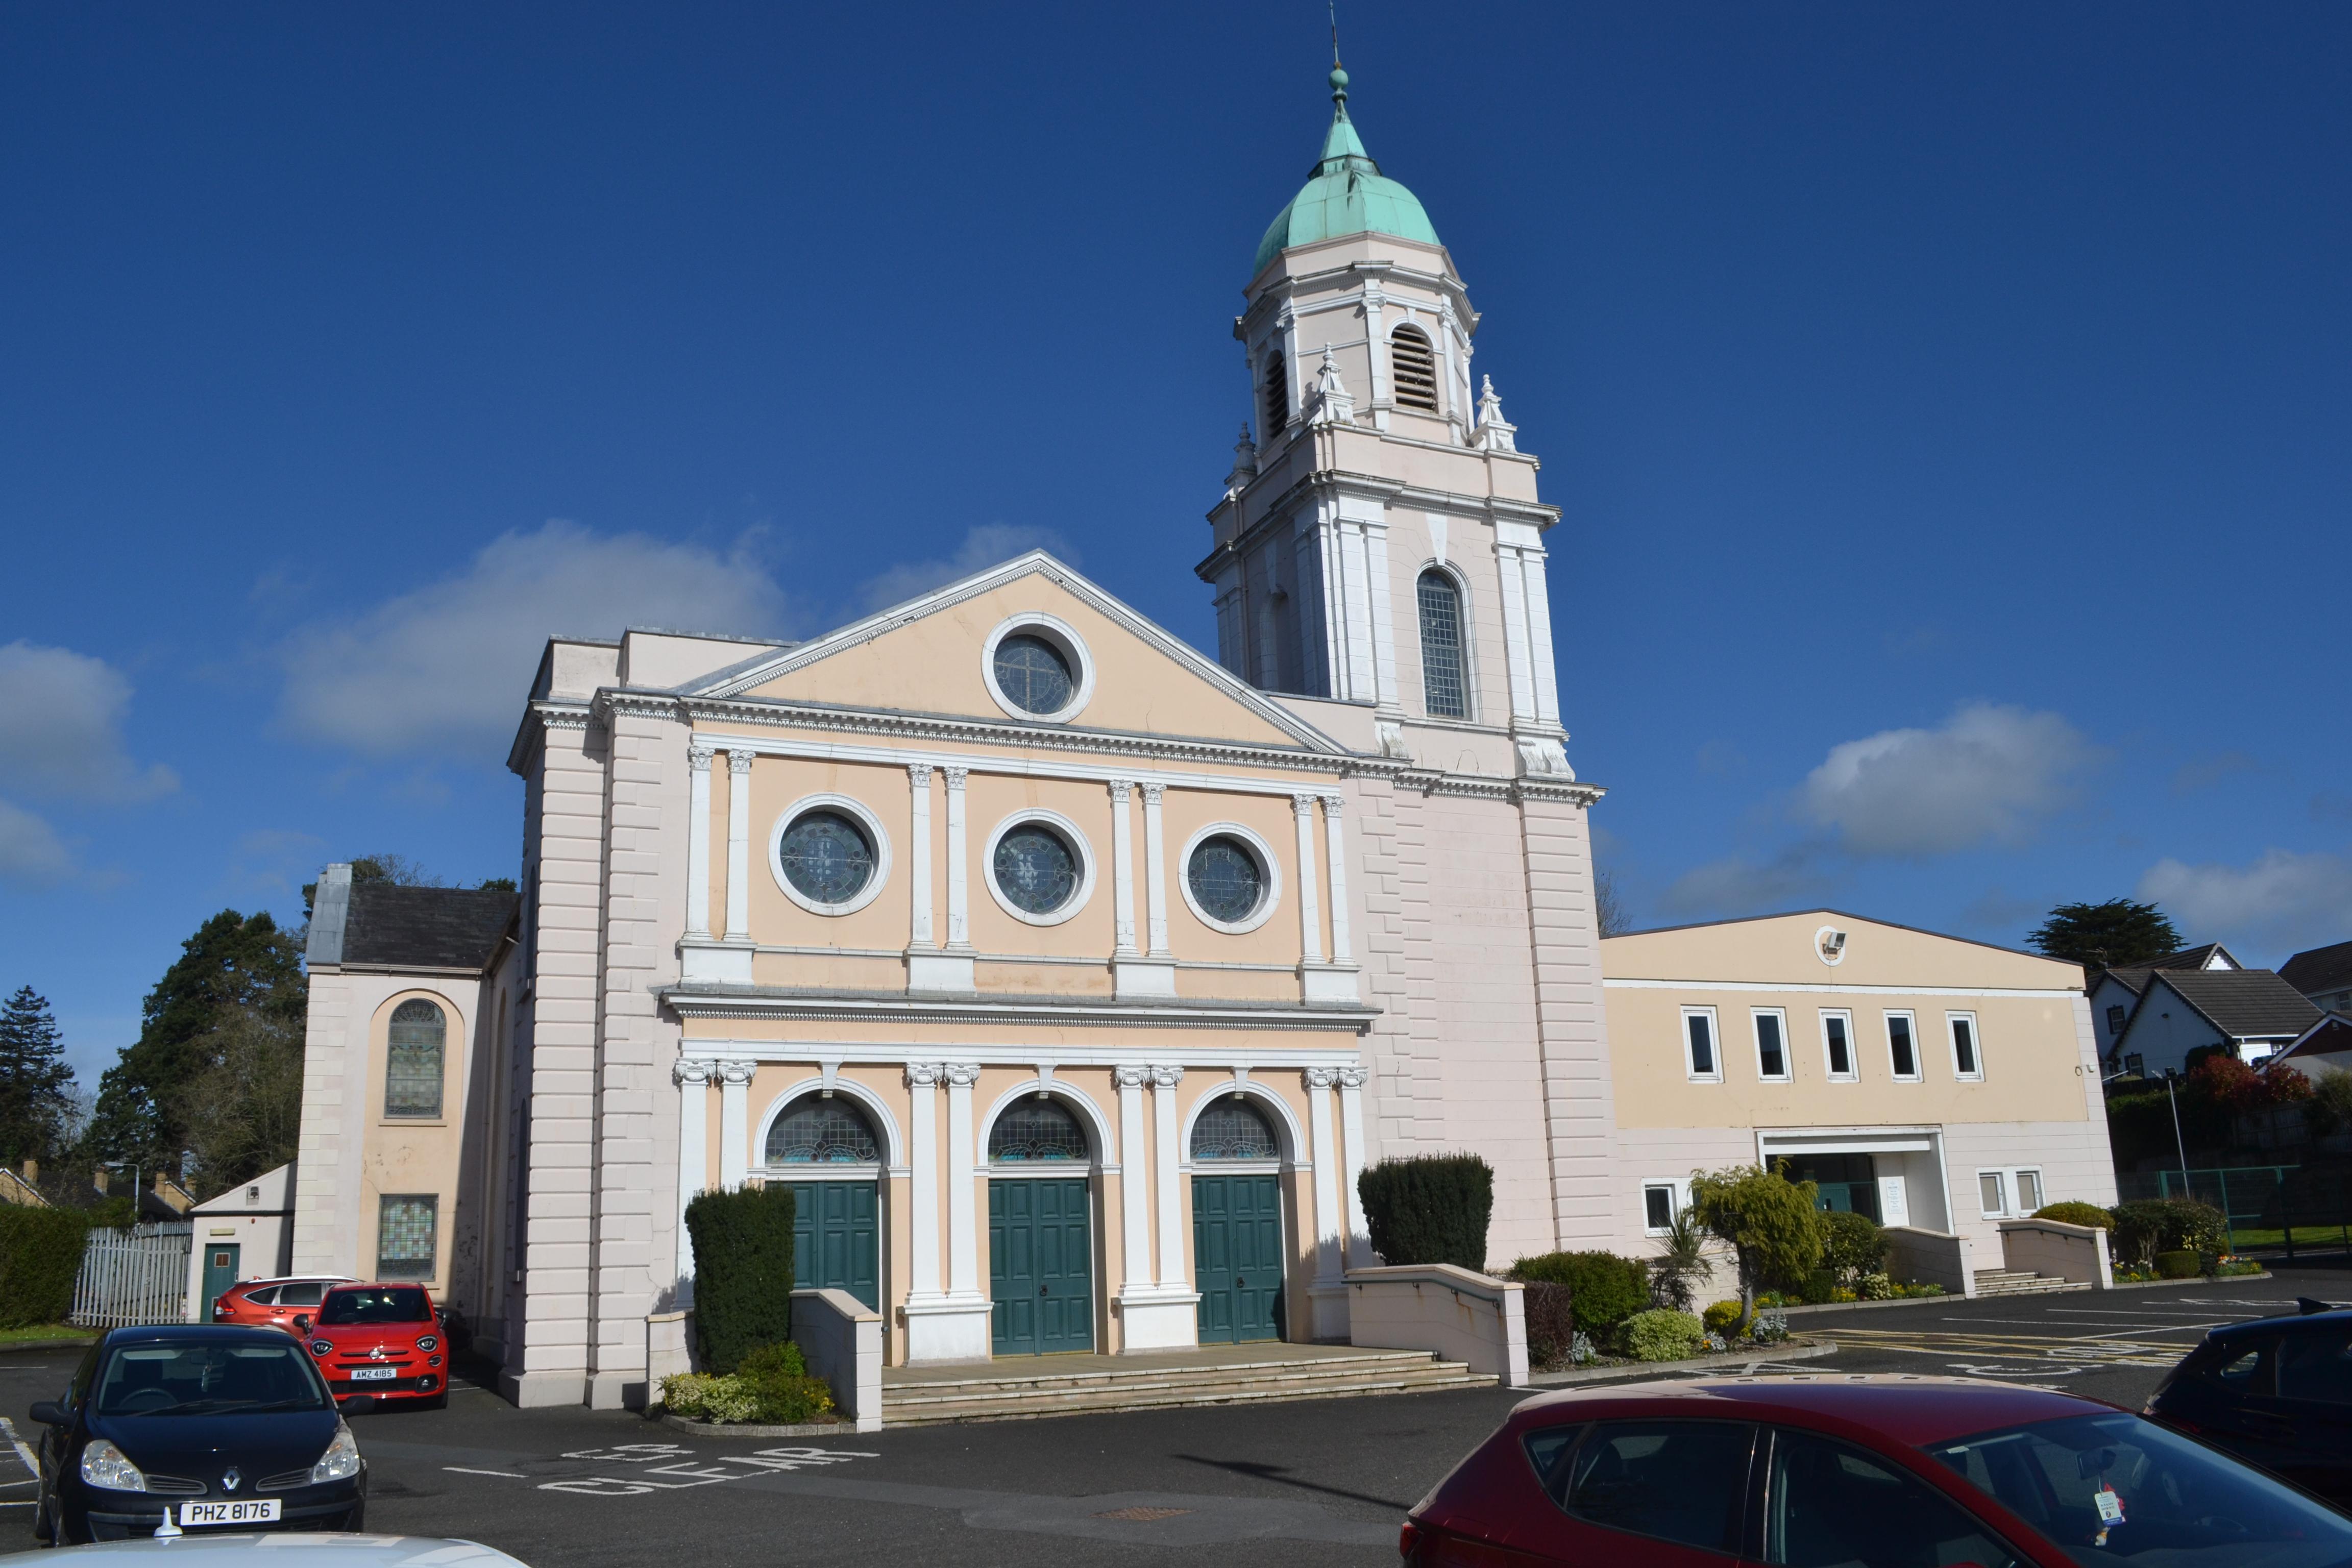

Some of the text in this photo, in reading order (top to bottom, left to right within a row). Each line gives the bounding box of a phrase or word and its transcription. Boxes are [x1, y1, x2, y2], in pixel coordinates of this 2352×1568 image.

[356, 1370, 372, 1379] AMZ
[537, 1447, 881, 1495] CLEAR
[192, 1502, 271, 1522] PHZ 8176
